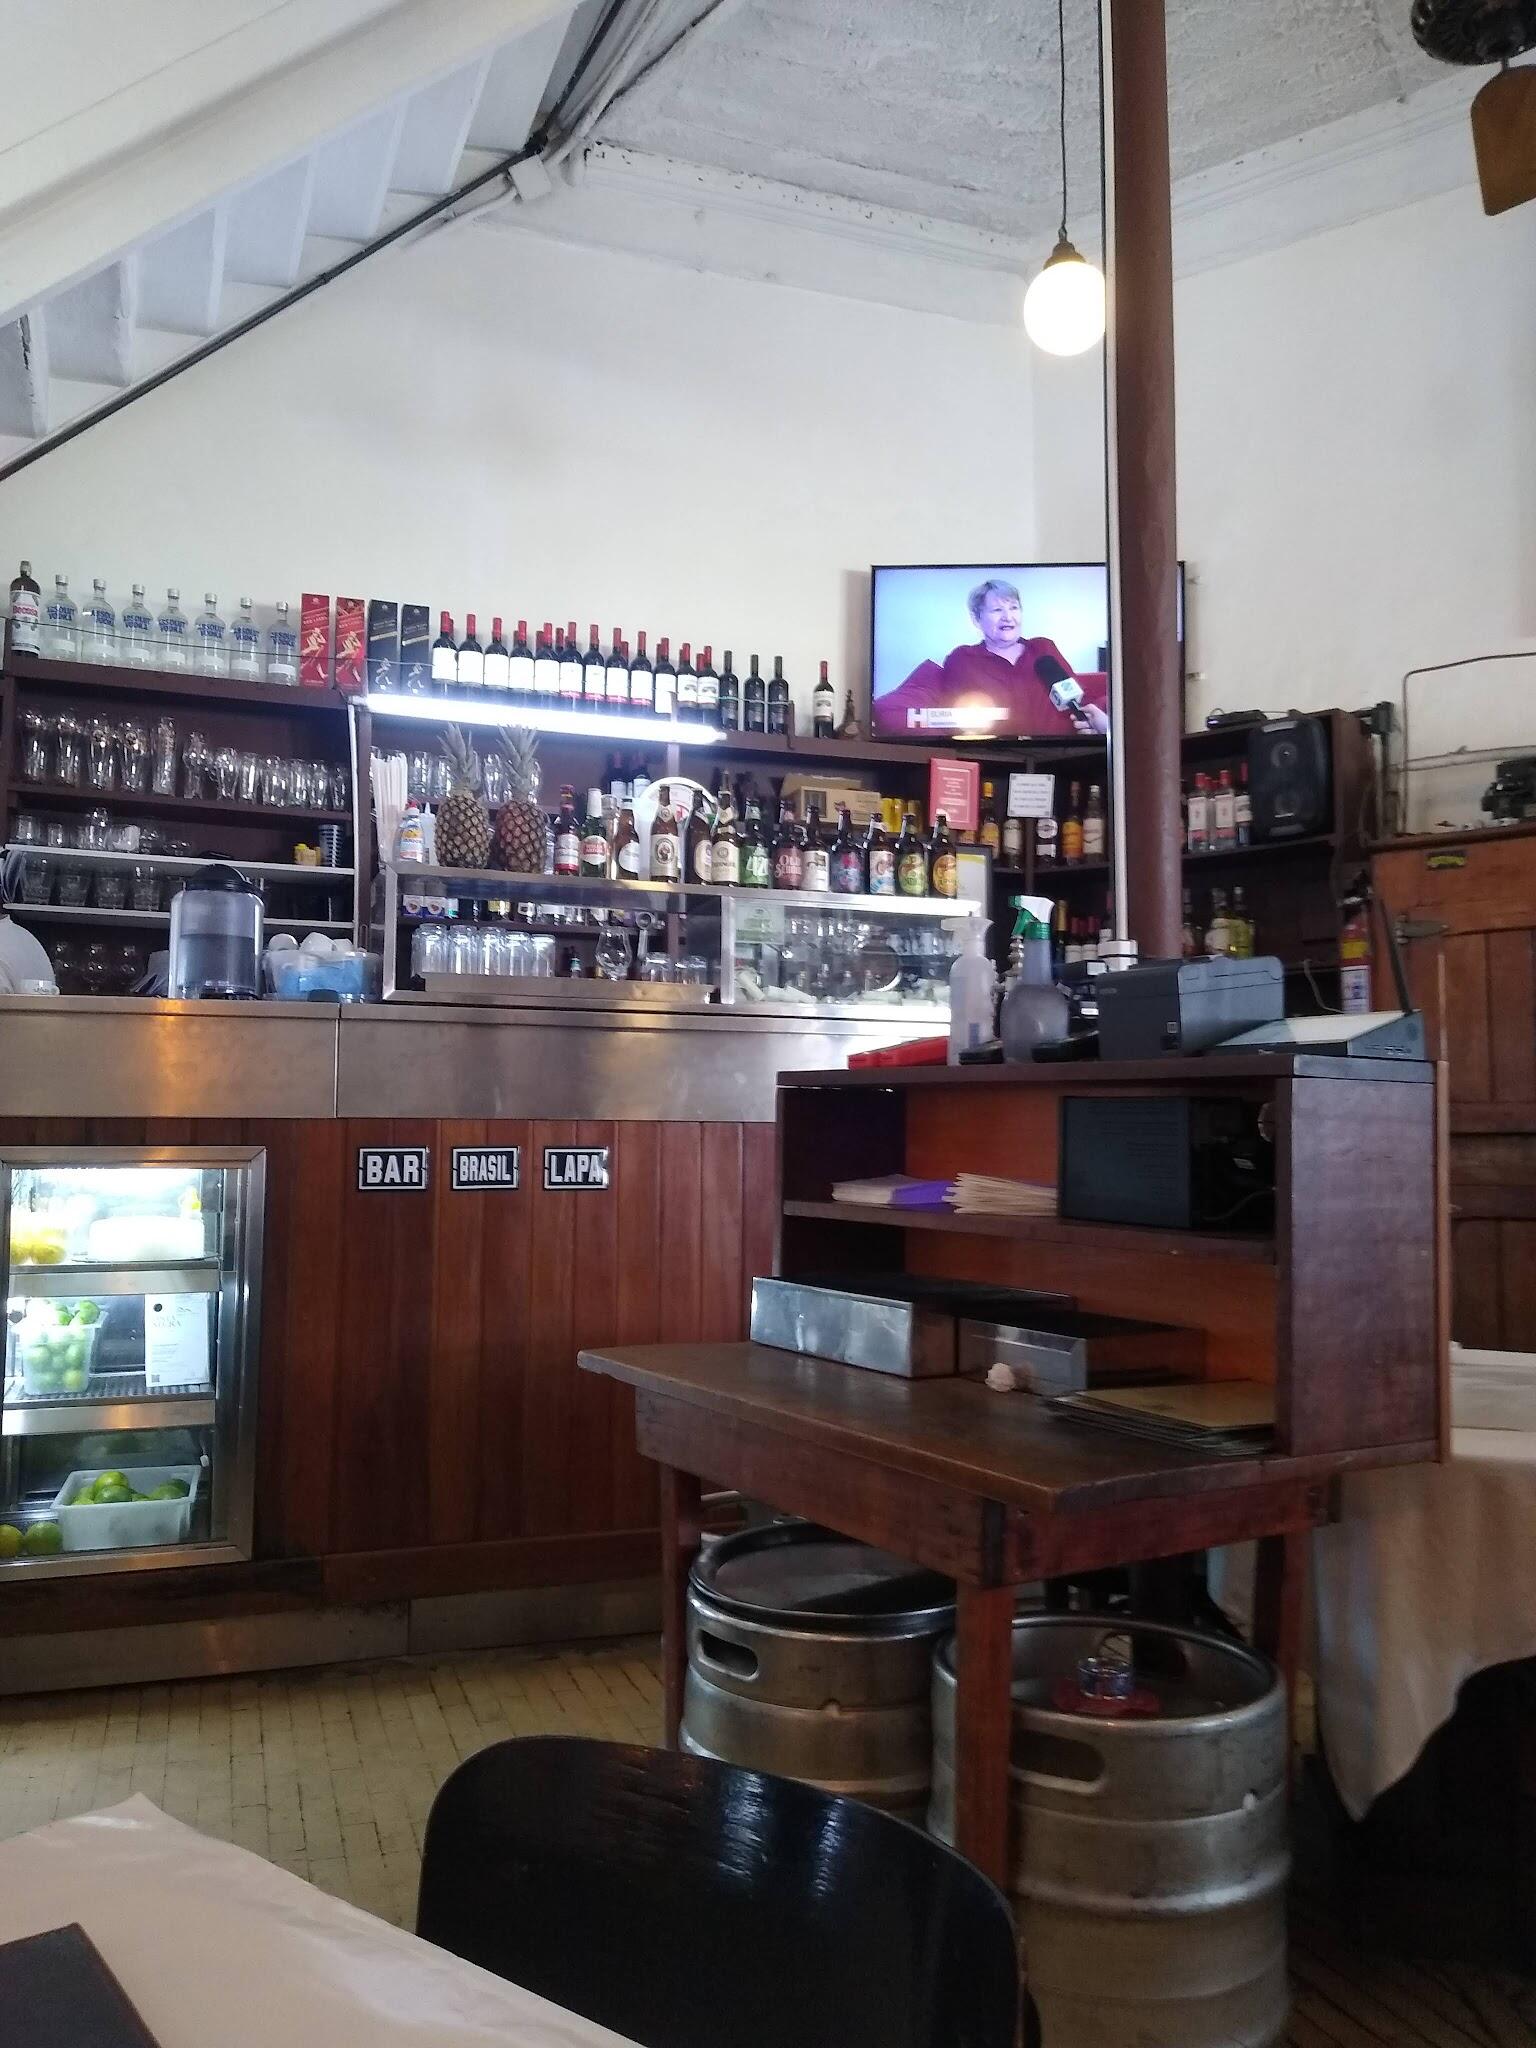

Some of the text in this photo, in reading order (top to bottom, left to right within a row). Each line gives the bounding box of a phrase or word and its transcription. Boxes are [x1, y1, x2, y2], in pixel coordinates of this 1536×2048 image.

[366, 1155, 419, 1183] BAR
[459, 1155, 511, 1181] BRASIL
[550, 1154, 602, 1182] LAPA
